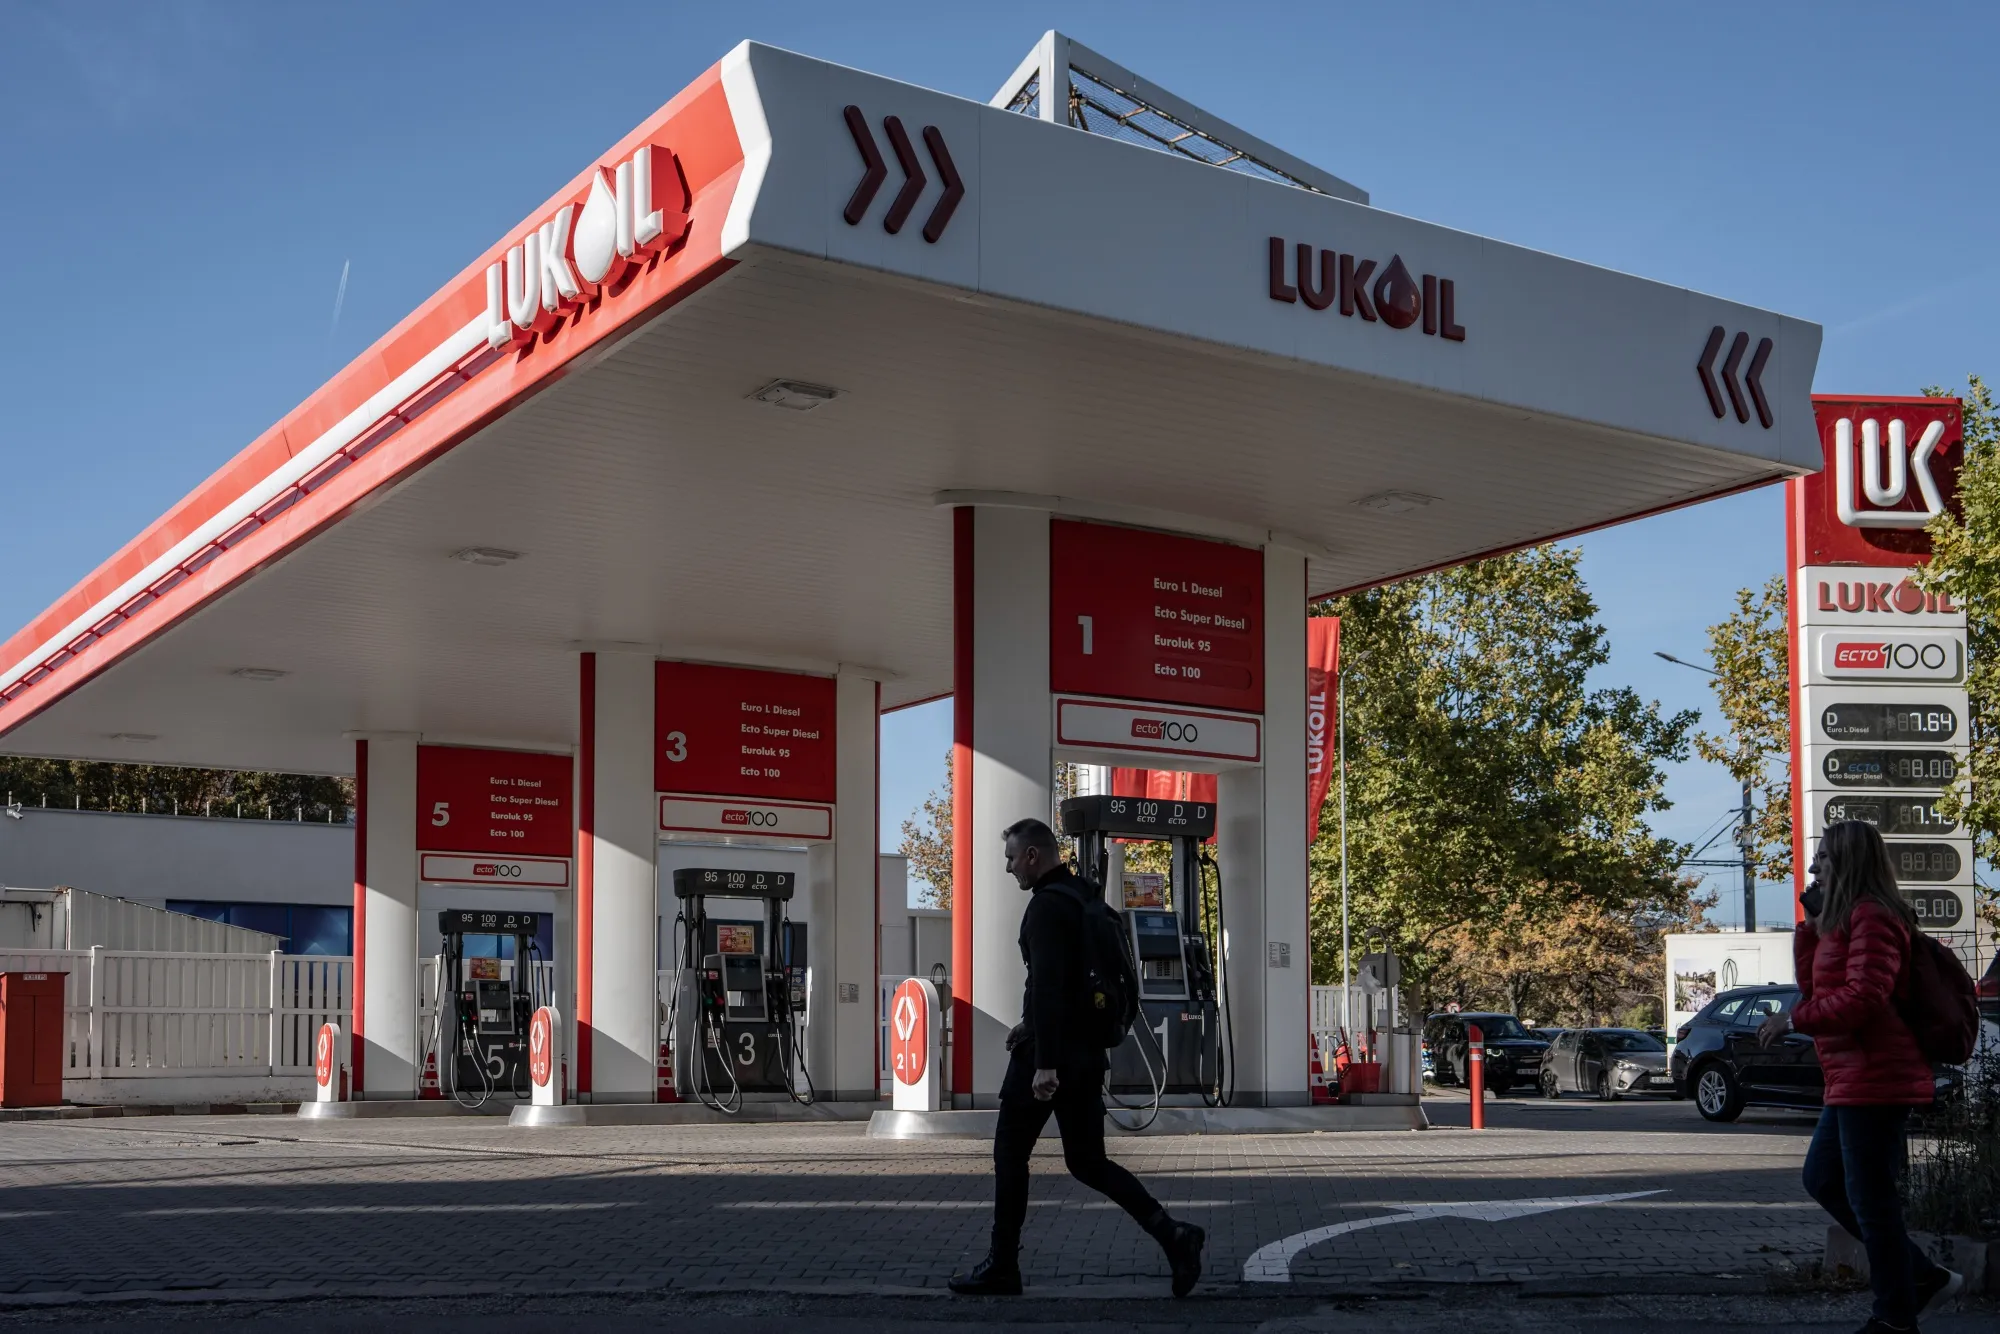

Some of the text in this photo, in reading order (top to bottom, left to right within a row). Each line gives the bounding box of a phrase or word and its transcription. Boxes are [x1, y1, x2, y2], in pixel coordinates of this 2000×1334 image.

[487, 146, 662, 350] LUKOIL
[1269, 236, 1465, 342] LUKOIL
[1835, 418, 1946, 528] LUK
[1153, 578, 1223, 598] Euro L Diesel
[1818, 576, 1956, 614] LUKOIL
[1154, 606, 1245, 630] Ecto Super Diesel
[1078, 615, 1093, 655] 1
[1154, 635, 1211, 652] Euroluk 95
[1154, 664, 1201, 679] Ecto 100
[741, 702, 800, 717] Euro L Diesel
[1826, 712, 1952, 732] D 7.64
[741, 724, 820, 739] Ecto Super Diesel
[1308, 692, 1325, 775] LUKOIL
[665, 731, 687, 762] 3
[741, 746, 790, 758] Euroluk 95
[740, 767, 780, 778] Ecto 100
[1828, 758, 1840, 772] D
[1848, 763, 1881, 773] ECTO
[490, 777, 542, 788] Euro L Diesel
[490, 795, 559, 807] Ecto Super Diesel
[1110, 800, 1207, 819] 95 100 D D
[431, 802, 450, 827] 5
[491, 812, 521, 821] Euroluk
[1829, 805, 1845, 819] 95
[490, 829, 525, 838] Ecto 100
[704, 872, 786, 885] 95 100 D D
[461, 913, 531, 924] 95 100 D D
[738, 1032, 755, 1065] 3
[1154, 1017, 1168, 1072] 1
[487, 1045, 505, 1079] 5
[532, 1062, 545, 1075] 4 3
[896, 1053, 916, 1070] 2 1
[323, 1067, 328, 1077] 5
